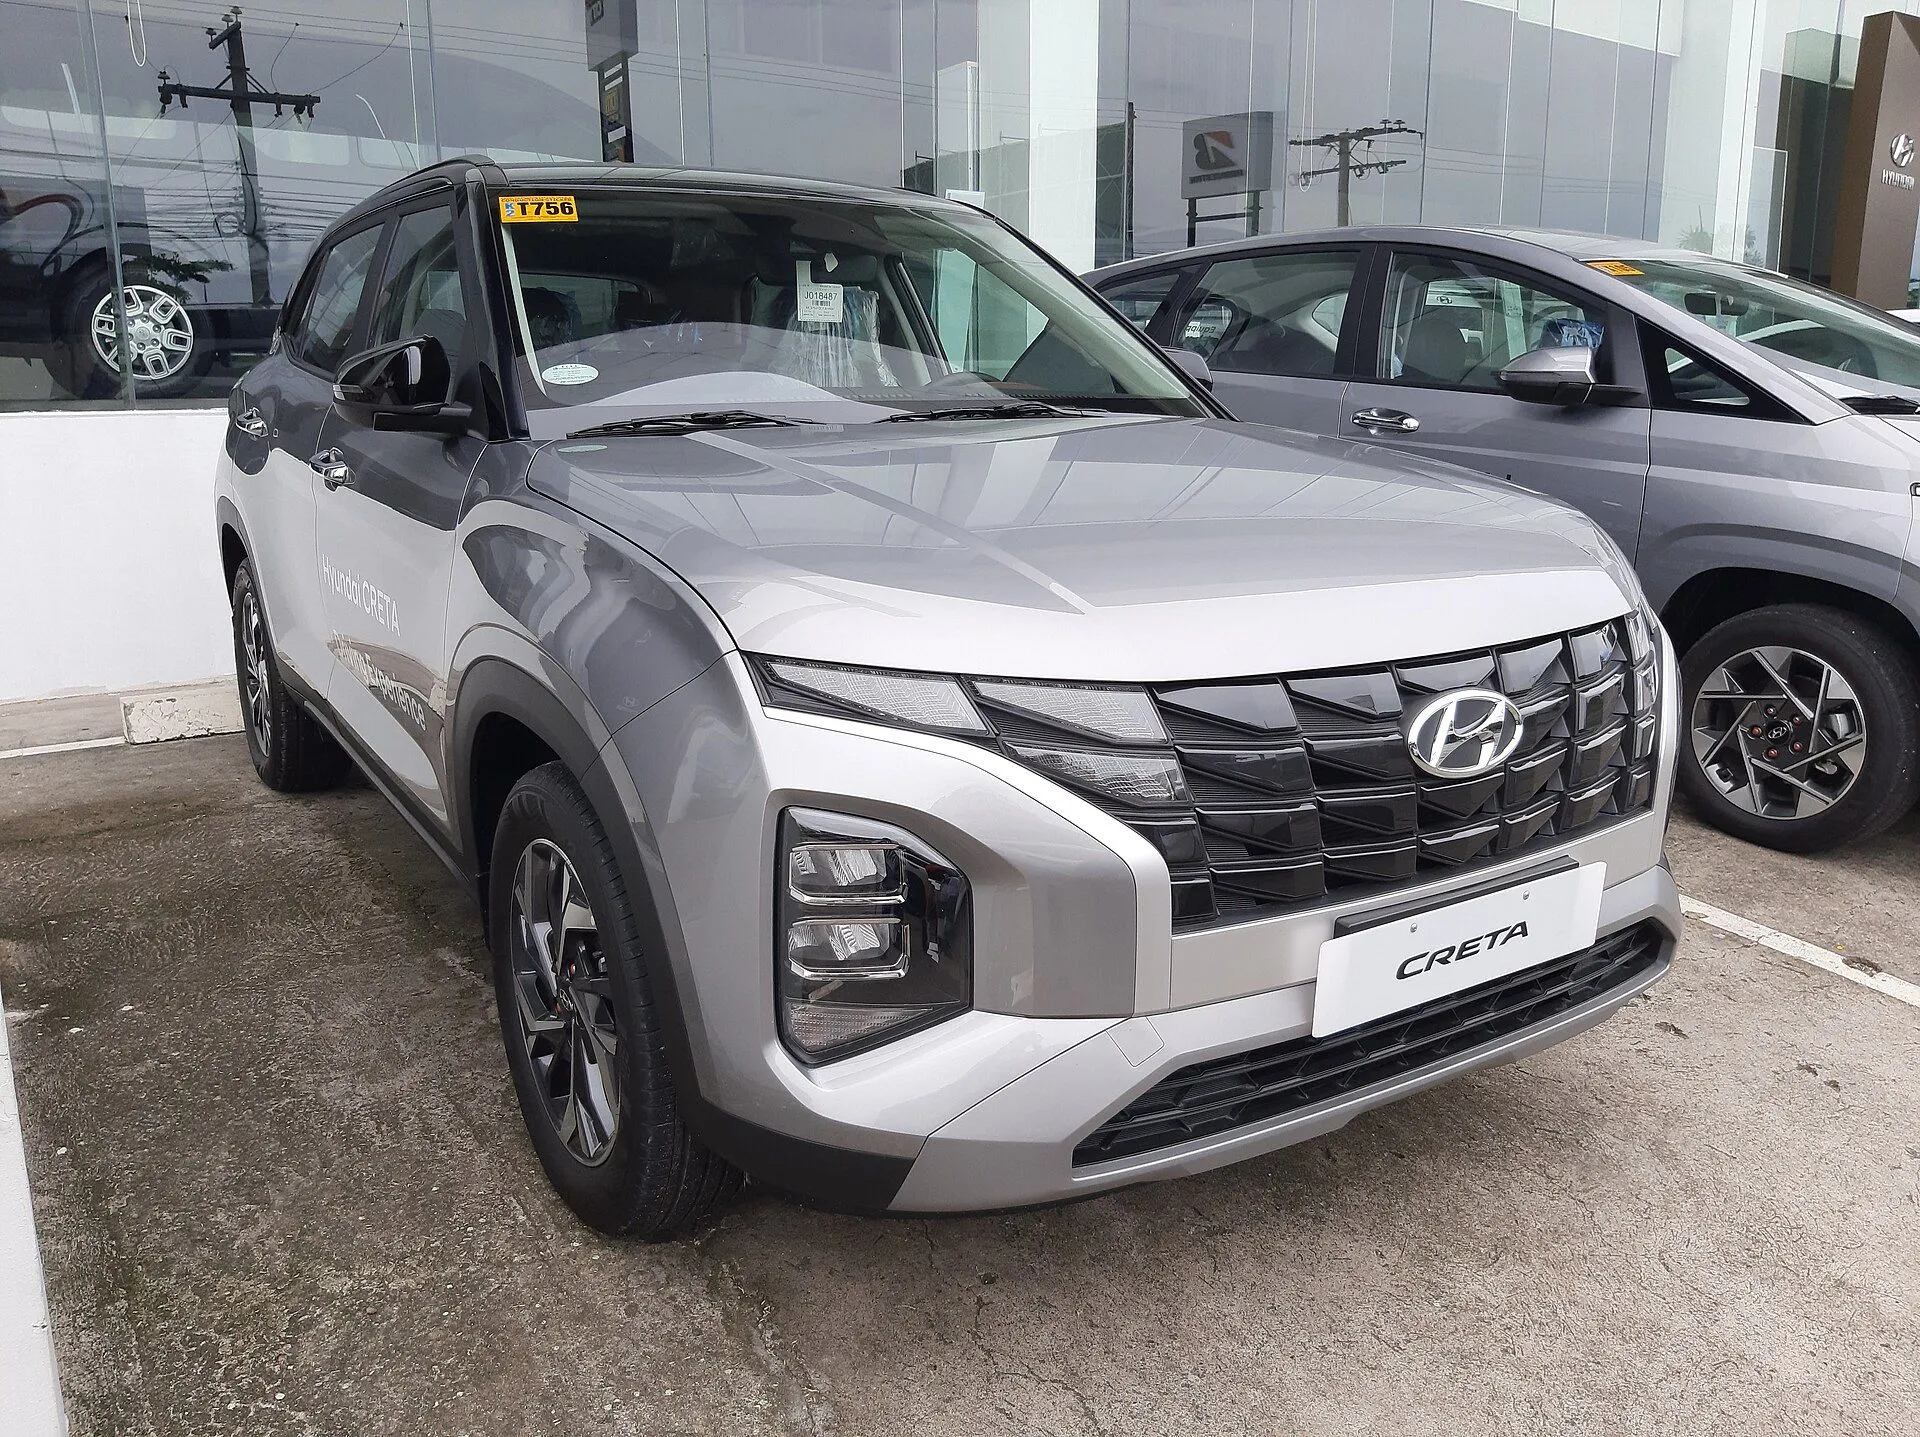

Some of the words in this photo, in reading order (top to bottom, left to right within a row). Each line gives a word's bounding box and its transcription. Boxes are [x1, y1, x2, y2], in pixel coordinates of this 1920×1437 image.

[517, 201, 574, 216] T756
[804, 291, 838, 301] J018487
[322, 553, 361, 608] Hyundai
[362, 580, 400, 637] CRETA
[365, 652, 427, 732] Experience
[1396, 920, 1529, 980] CRETA
